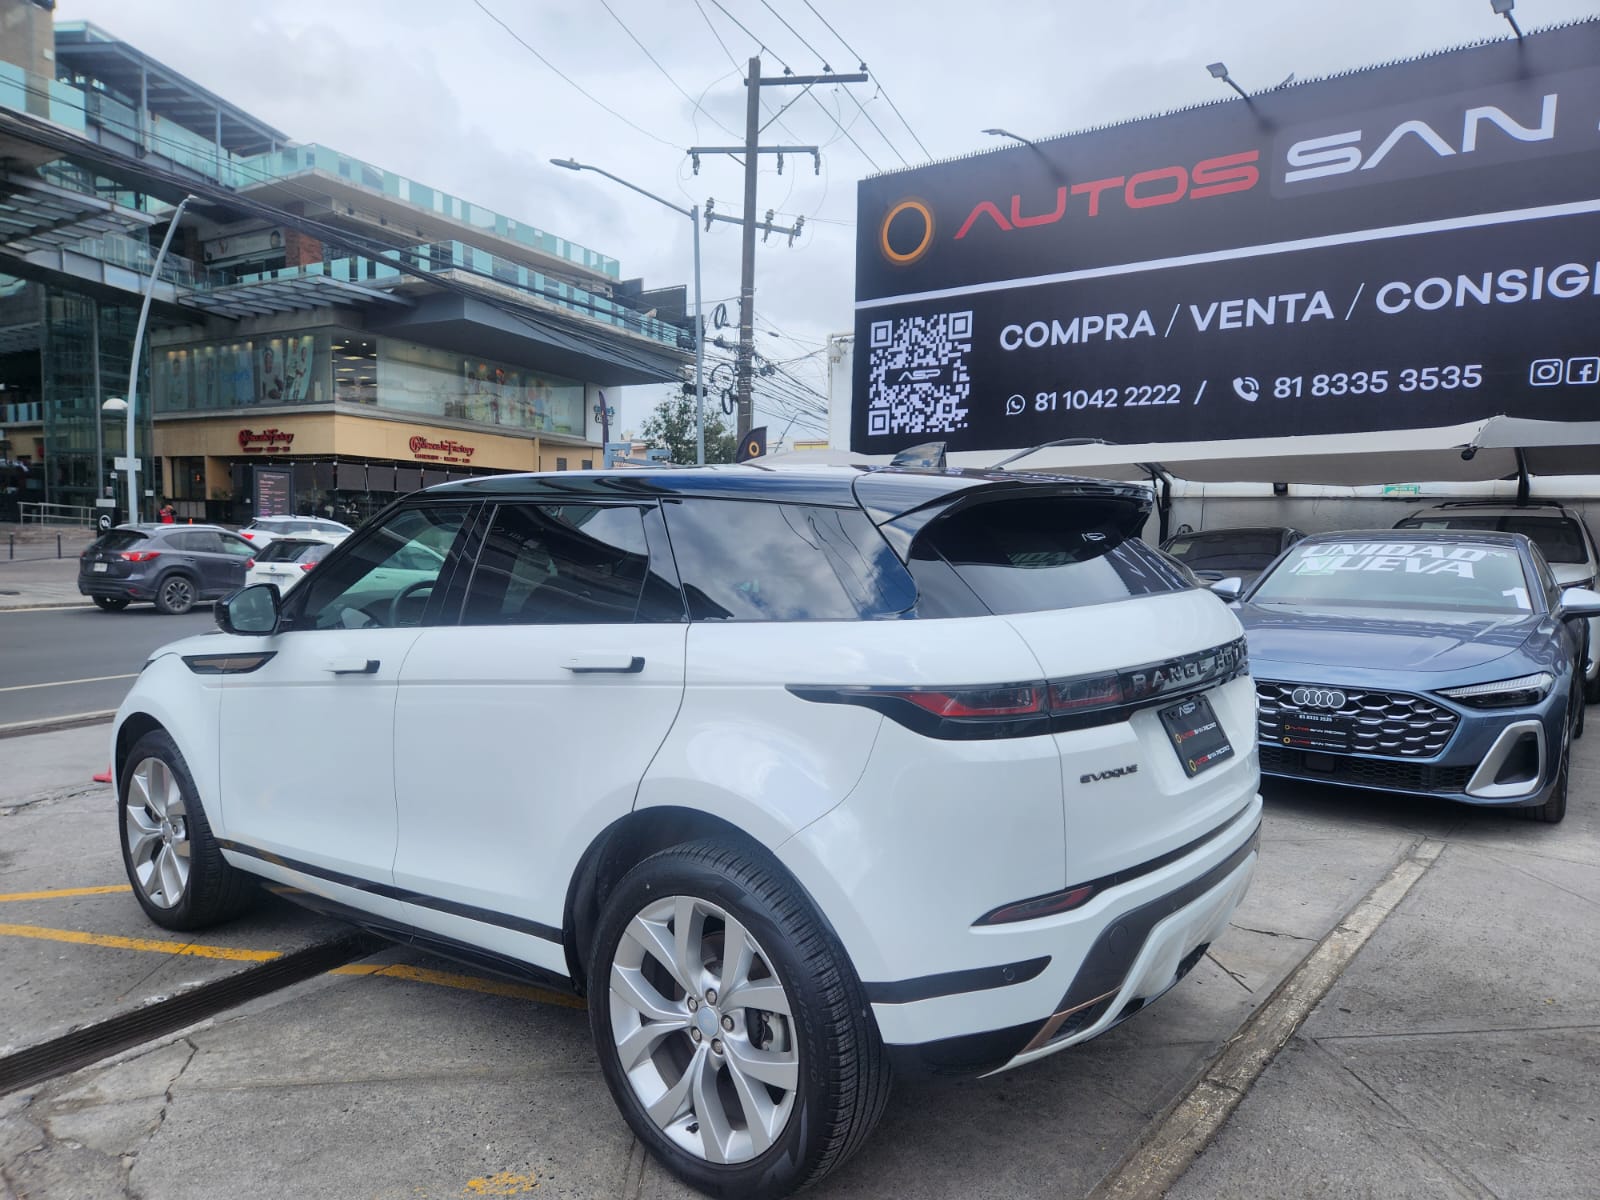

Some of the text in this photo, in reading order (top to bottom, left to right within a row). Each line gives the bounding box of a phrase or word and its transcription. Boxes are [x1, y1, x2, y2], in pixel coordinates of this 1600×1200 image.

[954, 93, 1558, 240] AUTOS SAN
[999, 262, 1600, 351] COMPRA / VENTA / CONSIG
[1034, 391, 1057, 412] 81
[1062, 387, 1118, 410] 1042
[1124, 384, 1181, 407] 2222
[1273, 376, 1302, 399] 81
[1311, 370, 1389, 397] 8335
[1398, 364, 1483, 392] 3535
[1289, 555, 1476, 580] NUEVA
[1300, 544, 1489, 562] UNIDAD
[1131, 660, 1208, 693] RANGE
[1080, 764, 1138, 784] EVOQUE
